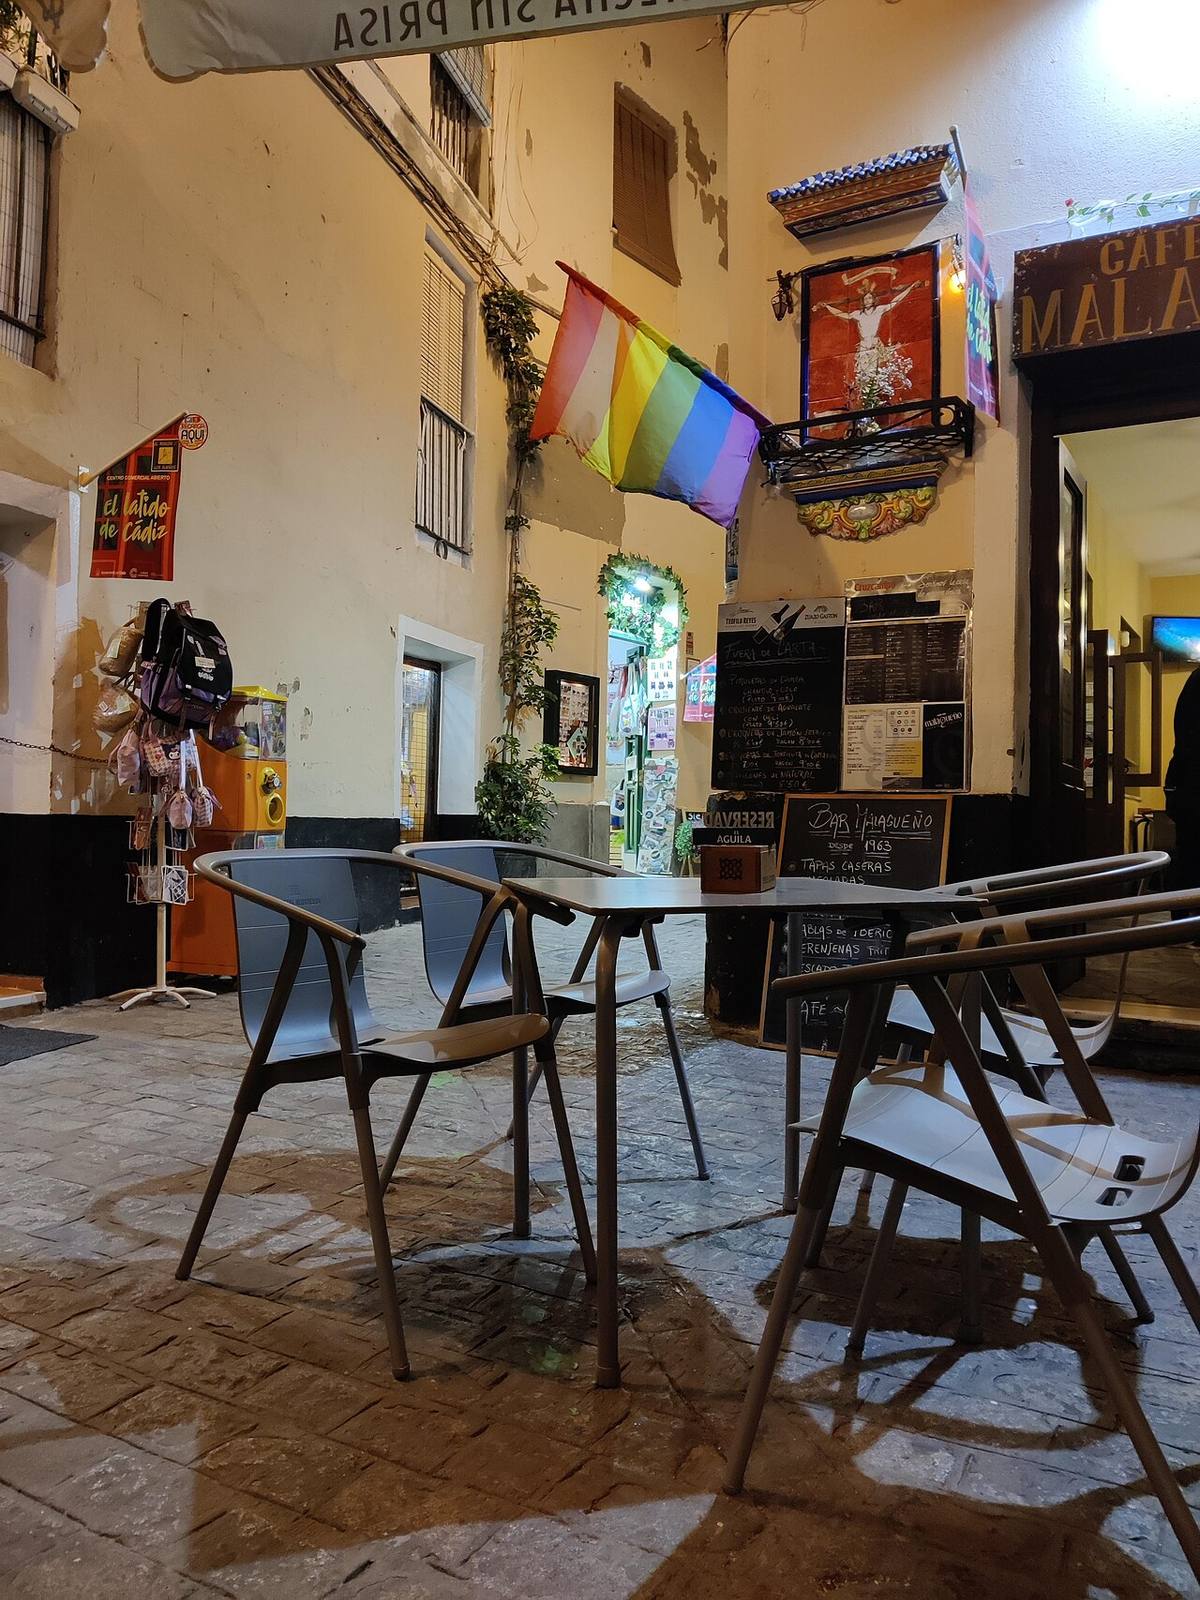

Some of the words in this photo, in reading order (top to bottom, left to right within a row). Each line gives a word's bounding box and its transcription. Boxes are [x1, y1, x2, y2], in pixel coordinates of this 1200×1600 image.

[103, 494, 119, 516] El
[123, 489, 172, 519] latido
[100, 519, 119, 540] de
[122, 519, 168, 544] Cádiz
[808, 803, 850, 839] BAR
[855, 804, 933, 841] MALAGUEÑO
[863, 840, 892, 851] 1963
[801, 858, 835, 873] TAPAS
[841, 859, 892, 873] CASERAS
[801, 924, 833, 940] ABLAS
[801, 942, 861, 957] ERENJENAS
[867, 944, 890, 956] FRIT
